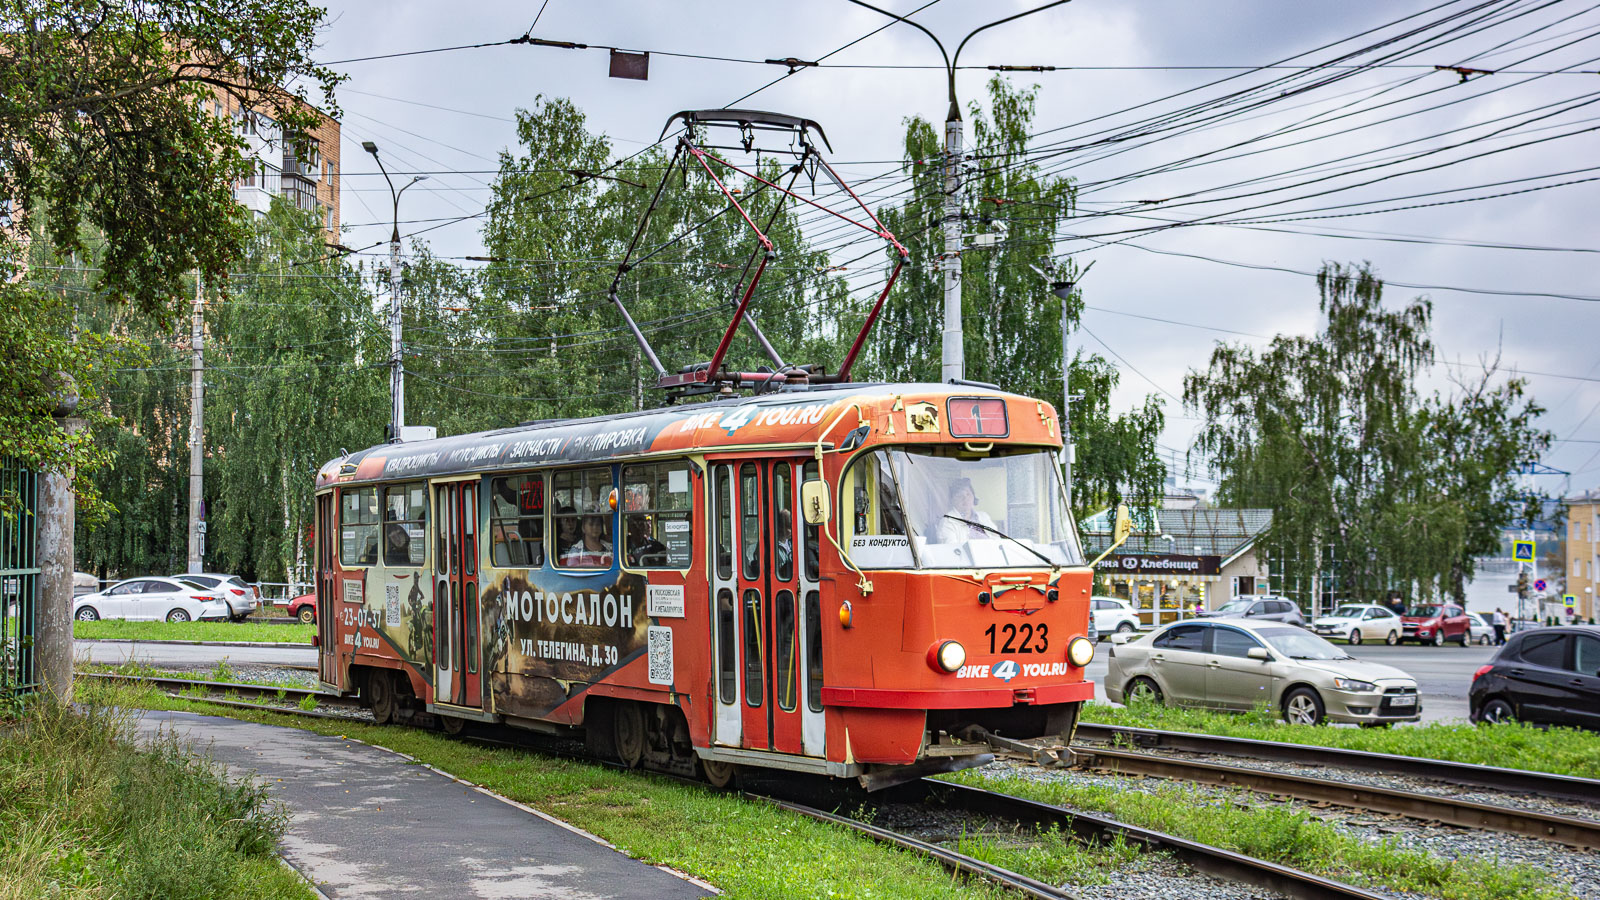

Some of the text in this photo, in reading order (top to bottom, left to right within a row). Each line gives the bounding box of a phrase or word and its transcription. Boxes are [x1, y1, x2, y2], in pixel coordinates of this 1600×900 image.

[680, 403, 828, 432] BIKE 4 YOU.RU
[971, 404, 983, 434] 1
[385, 451, 441, 473] КВАДРОЦИКЛЫ
[509, 437, 563, 458] ЗАПЧАСТИ
[853, 539, 866, 547] БЕЗ
[1140, 559, 1199, 571] Хлебница
[344, 607, 382, 629] 23-07-37
[506, 590, 633, 628] МОТОСАЛОН
[354, 631, 362, 649] 4
[520, 638, 619, 667] УЛ. ТЕЛЕГИНА, Д. 30
[985, 623, 1048, 654] 1223
[956, 659, 1068, 680] BIKE 4 YOU.RU
